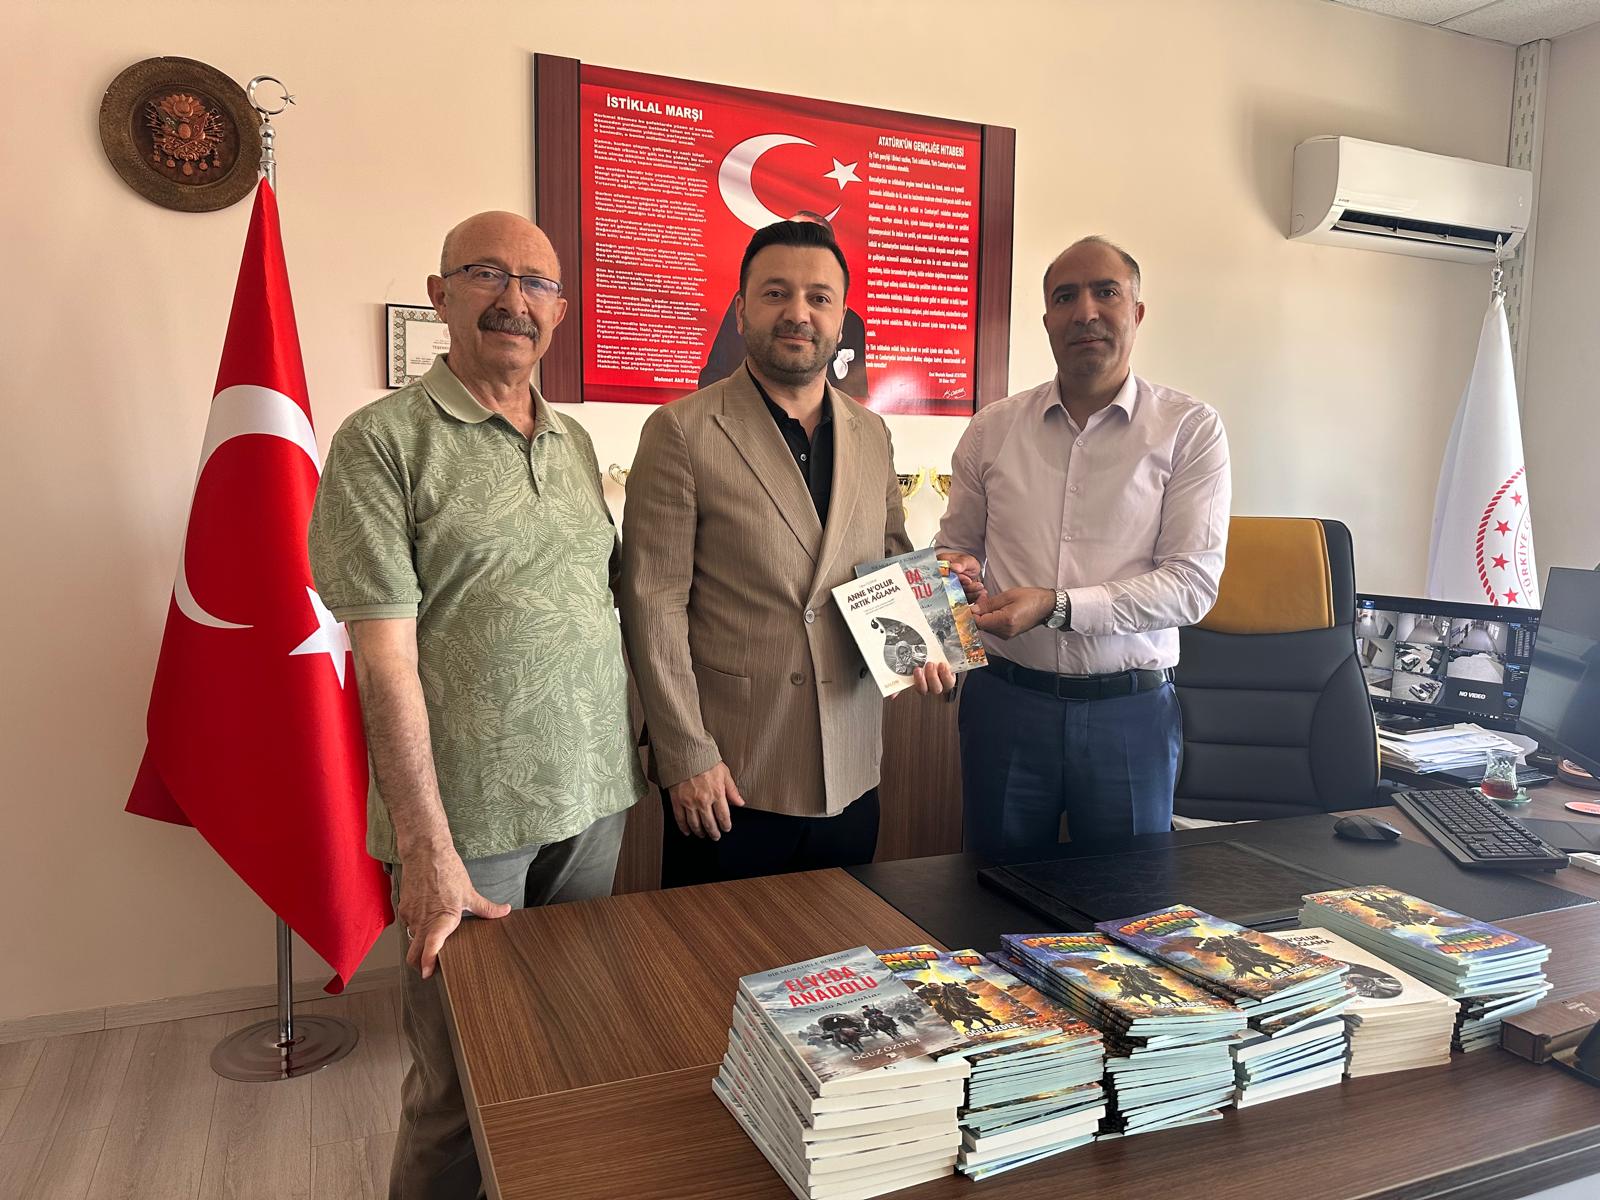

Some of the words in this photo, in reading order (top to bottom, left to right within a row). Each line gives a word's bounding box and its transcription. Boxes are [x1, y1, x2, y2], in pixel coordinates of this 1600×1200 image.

[606, 94, 662, 115] İSTİKLAL
[665, 104, 703, 122] MARŞI
[848, 590, 866, 603] ANNE
[867, 579, 894, 594] N'OLUR
[851, 597, 870, 611] ARTIK
[872, 585, 900, 602] AĞLAMA
[1469, 692, 1486, 700] VIDEO
[785, 966, 857, 992] ELVEDA
[788, 976, 879, 1007] ANADOLU
